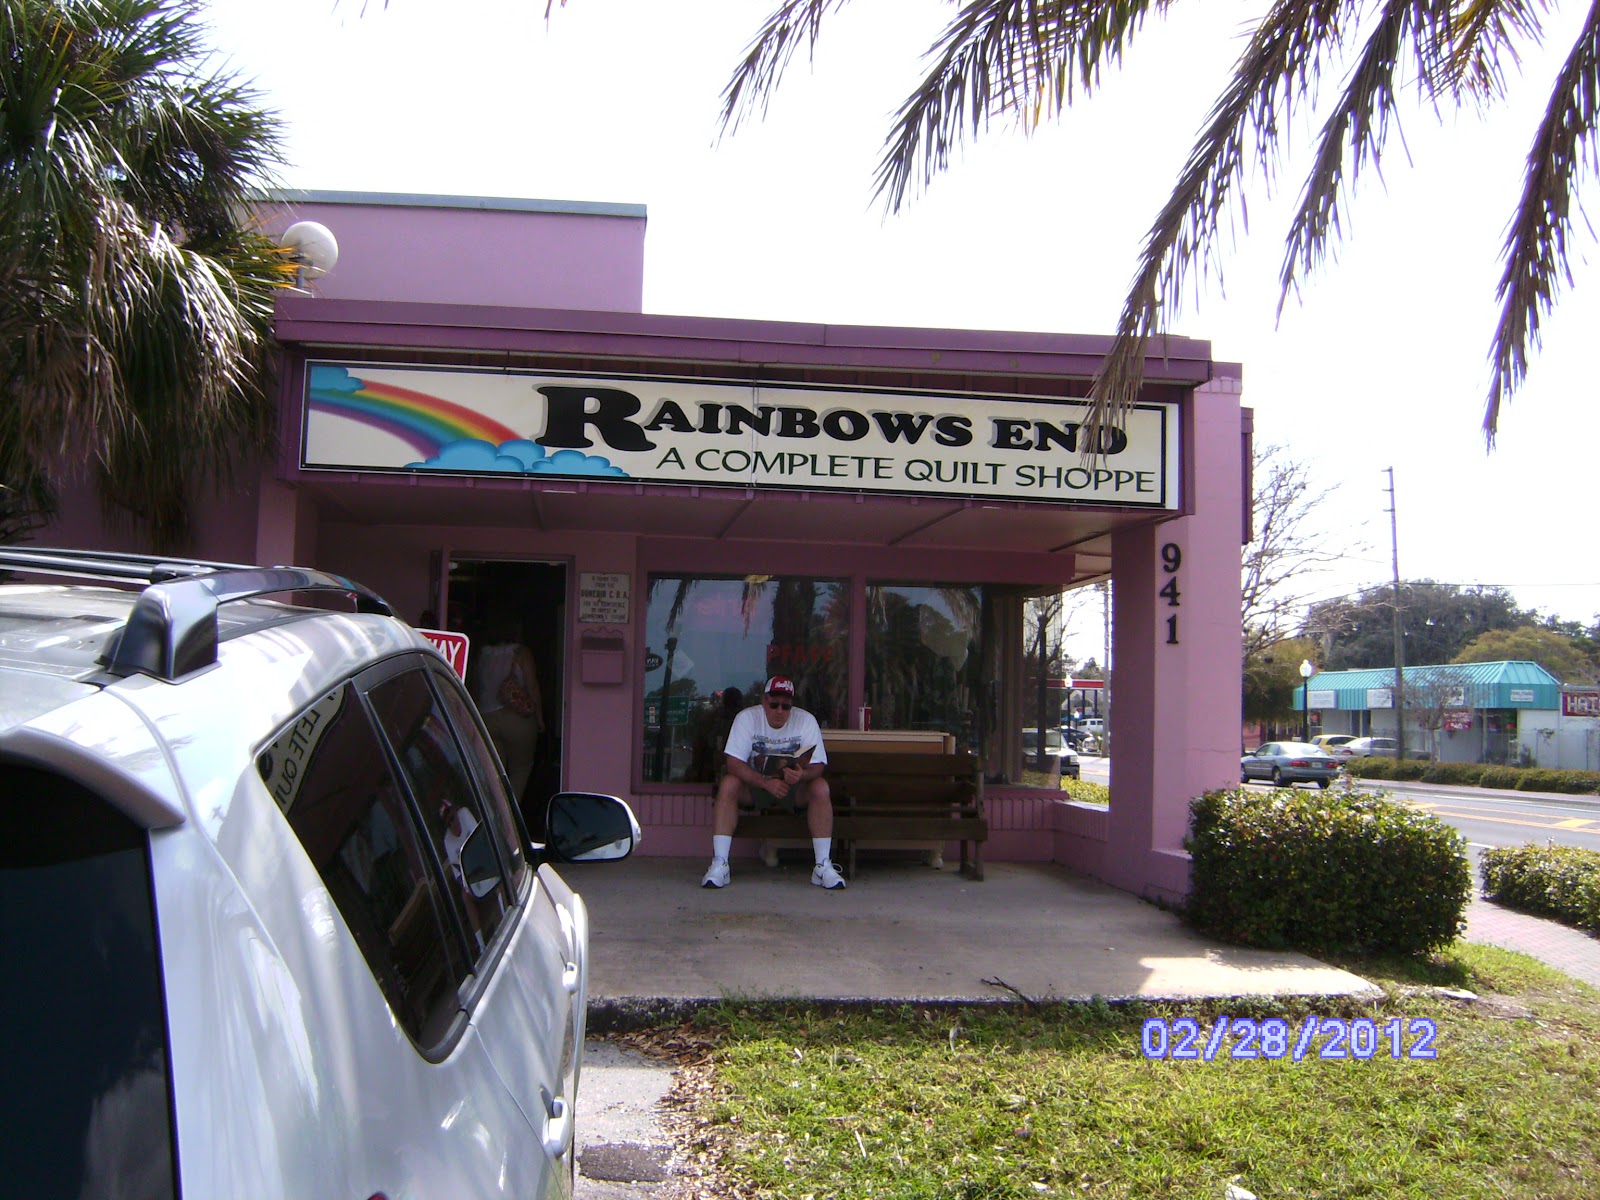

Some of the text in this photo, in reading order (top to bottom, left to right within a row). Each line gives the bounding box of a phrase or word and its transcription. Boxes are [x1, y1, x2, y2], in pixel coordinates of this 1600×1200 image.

[533, 384, 1128, 455] RAINBOWS END
[656, 447, 1156, 492] A COMPLETE QUILT SHOPPE
[1159, 543, 1182, 644] 941
